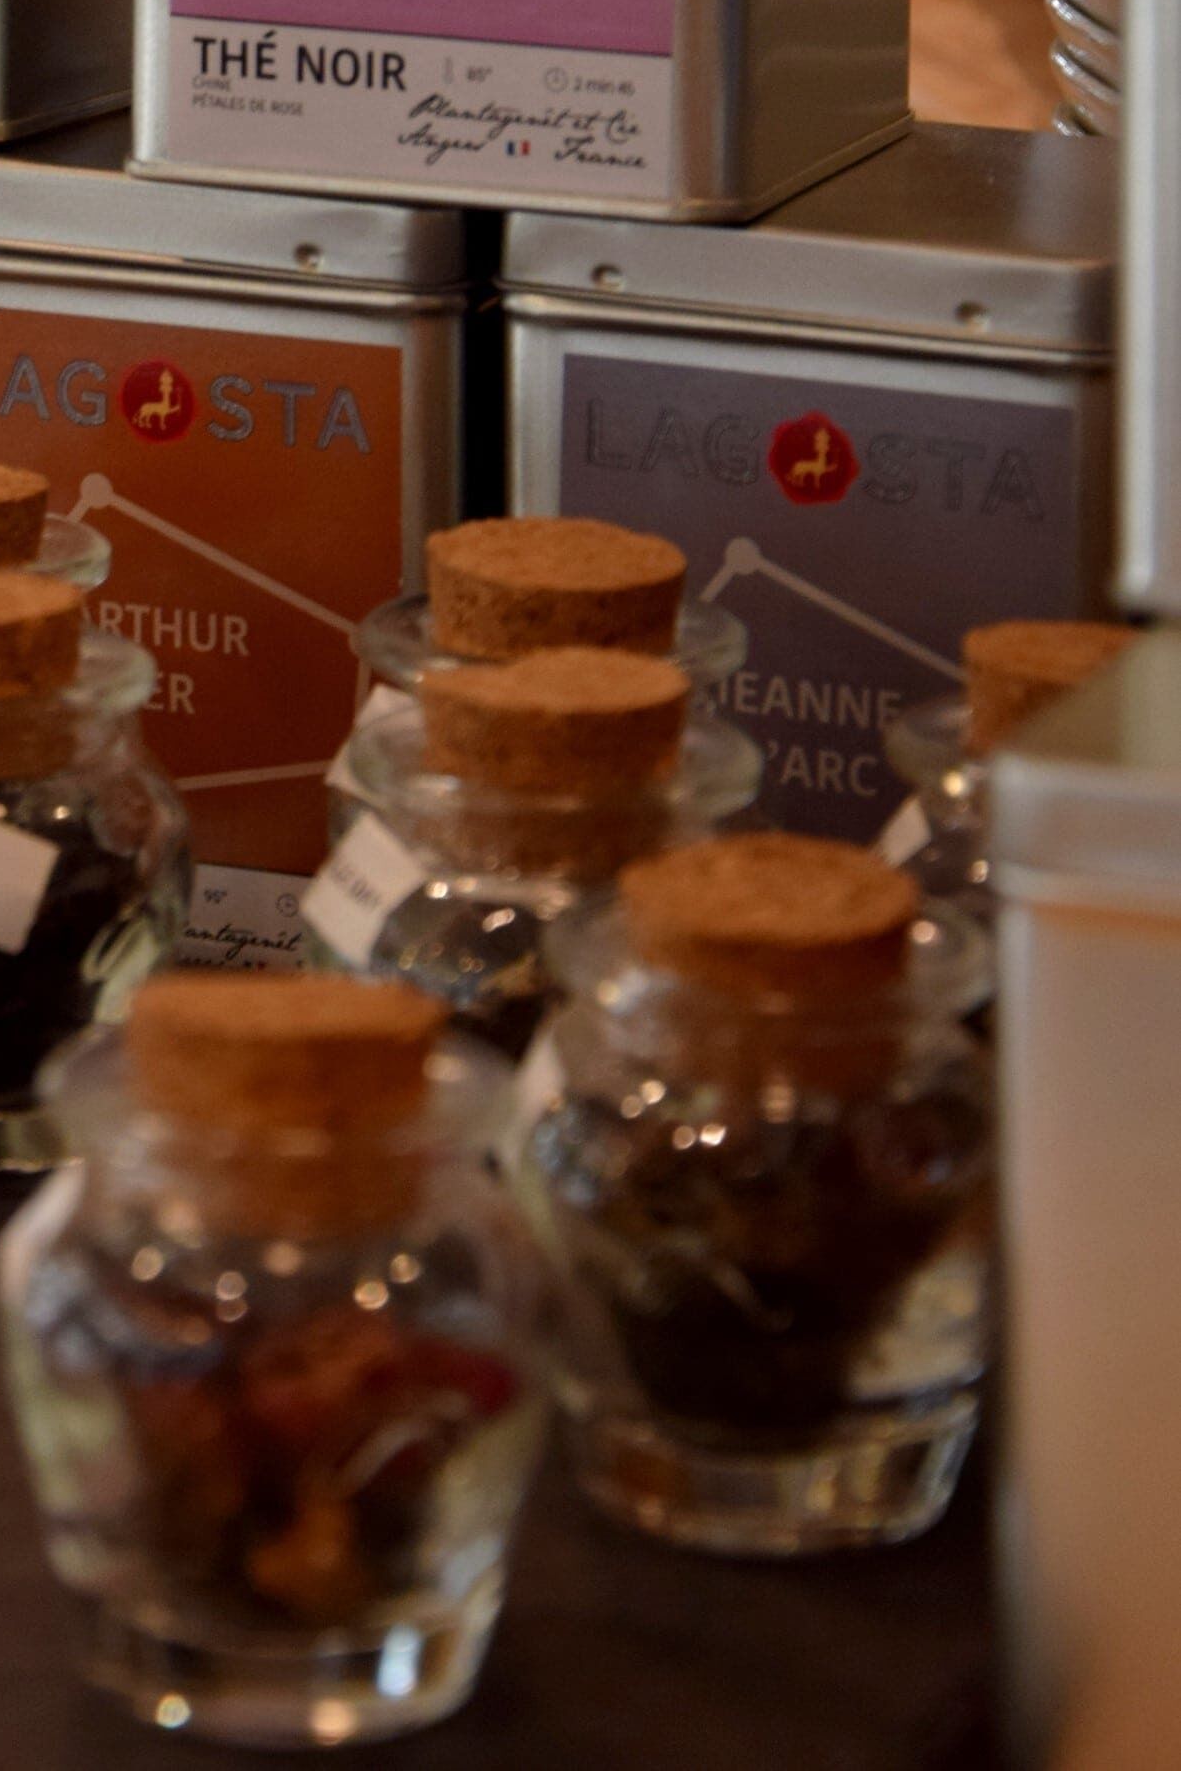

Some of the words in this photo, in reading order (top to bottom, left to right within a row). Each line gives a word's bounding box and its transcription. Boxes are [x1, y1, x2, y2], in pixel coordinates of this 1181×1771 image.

[193, 30, 277, 80] THÉ
[296, 44, 407, 92] NOIR
[554, 135, 646, 169] France
[767, 739, 879, 797] 'ARC
